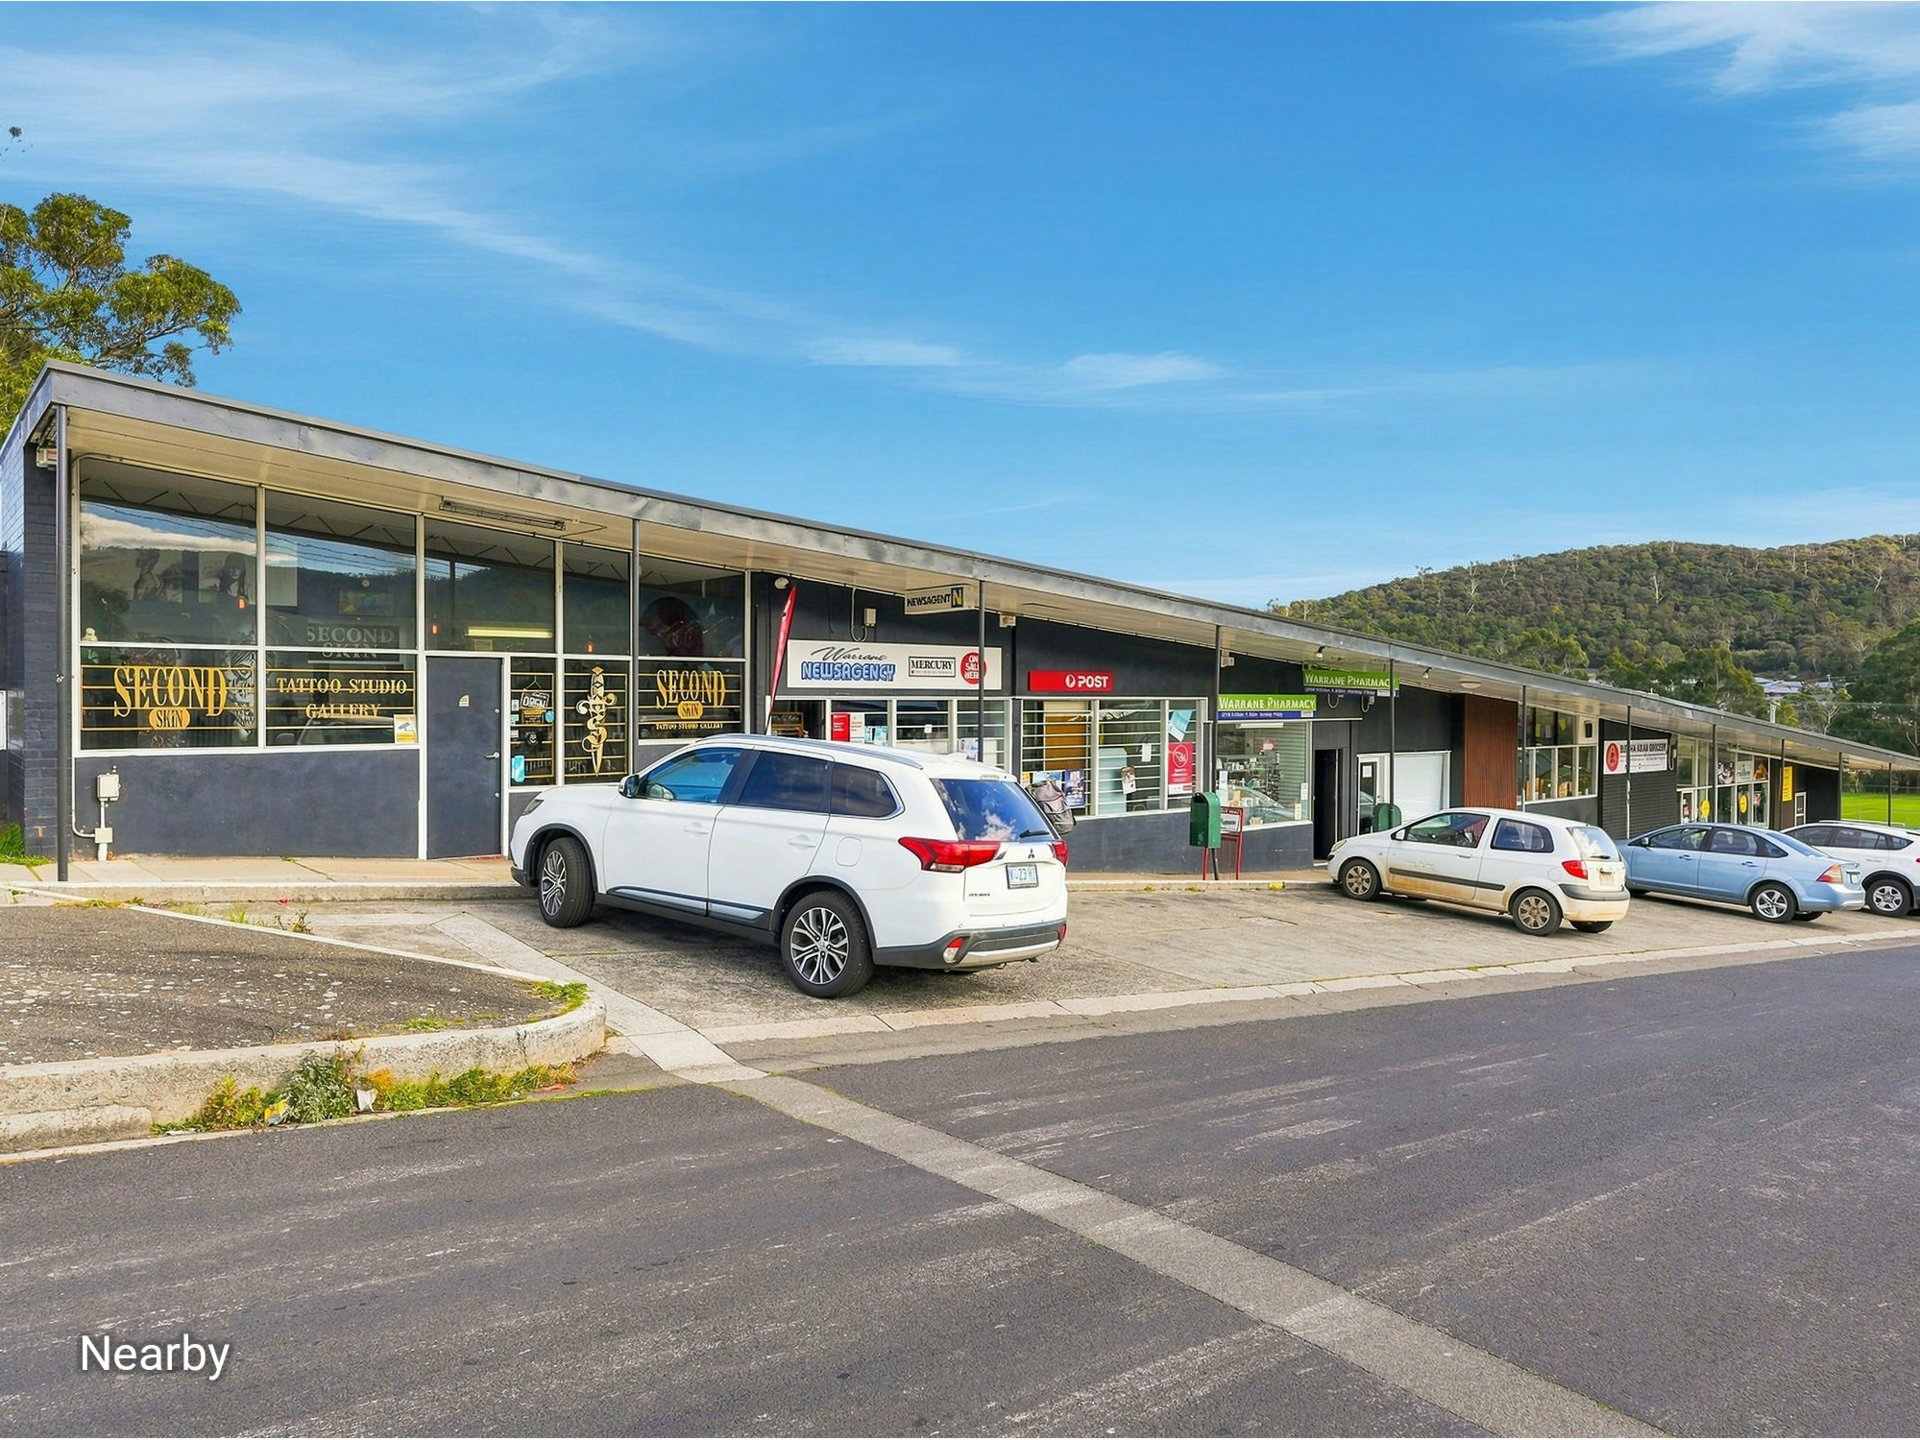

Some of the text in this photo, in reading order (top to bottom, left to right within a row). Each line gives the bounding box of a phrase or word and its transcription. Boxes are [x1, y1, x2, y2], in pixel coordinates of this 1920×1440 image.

[906, 593, 951, 607] NEWSAGENT
[306, 626, 395, 643] SECOND
[801, 661, 896, 682] NEWSAGENCY
[911, 659, 954, 670] MERCURY
[965, 662, 980, 671] SAL
[276, 677, 408, 695] TATTOO STUDIO
[1077, 675, 1109, 689] POST
[1304, 673, 1395, 688] WARRANE PHARMAC
[114, 666, 228, 718] SECOND
[656, 669, 726, 709] SECOND
[305, 703, 381, 719] GALLERY
[1219, 696, 1317, 710] WARRANE PHARMACY
[156, 708, 184, 728] SKIN
